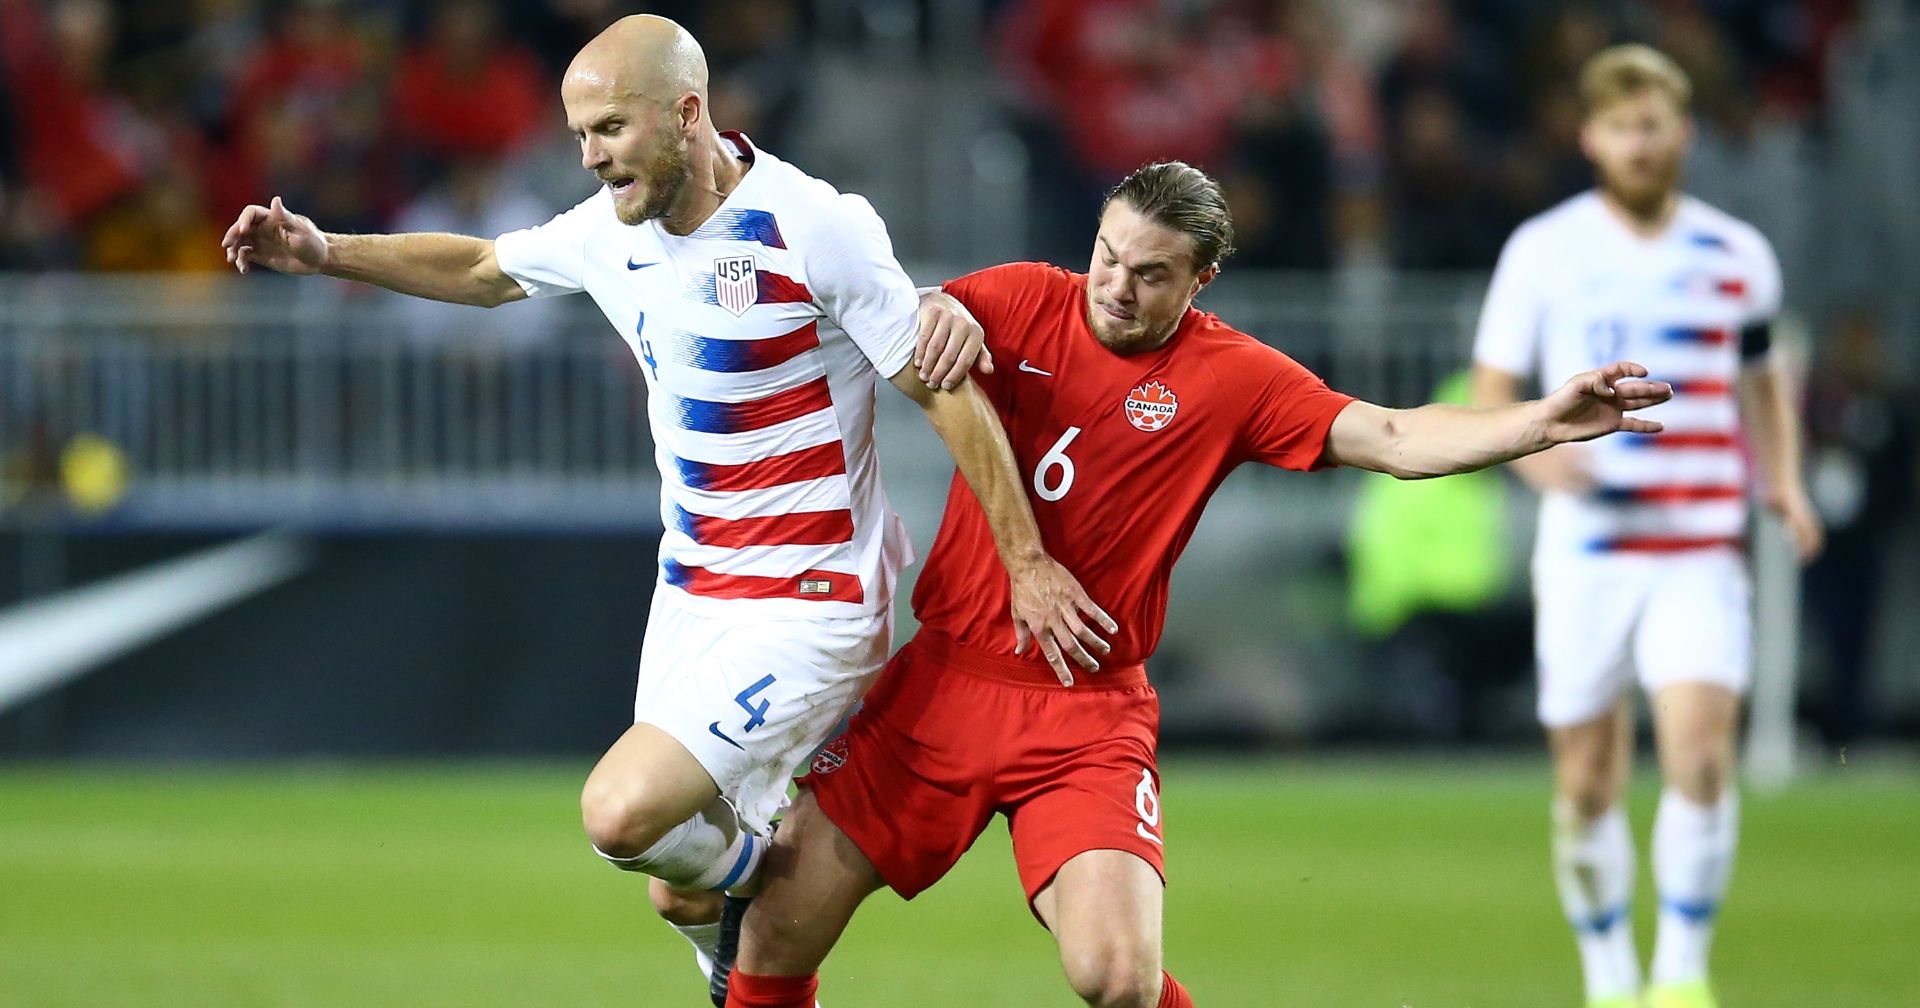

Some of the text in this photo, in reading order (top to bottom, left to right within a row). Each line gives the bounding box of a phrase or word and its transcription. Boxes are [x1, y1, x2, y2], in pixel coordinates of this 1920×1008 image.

[717, 260, 751, 282] USA
[637, 311, 658, 381] 4
[1127, 400, 1174, 414] CANADA
[1034, 426, 1081, 502] 6
[735, 673, 776, 733] 4
[1136, 768, 1158, 827] 6
